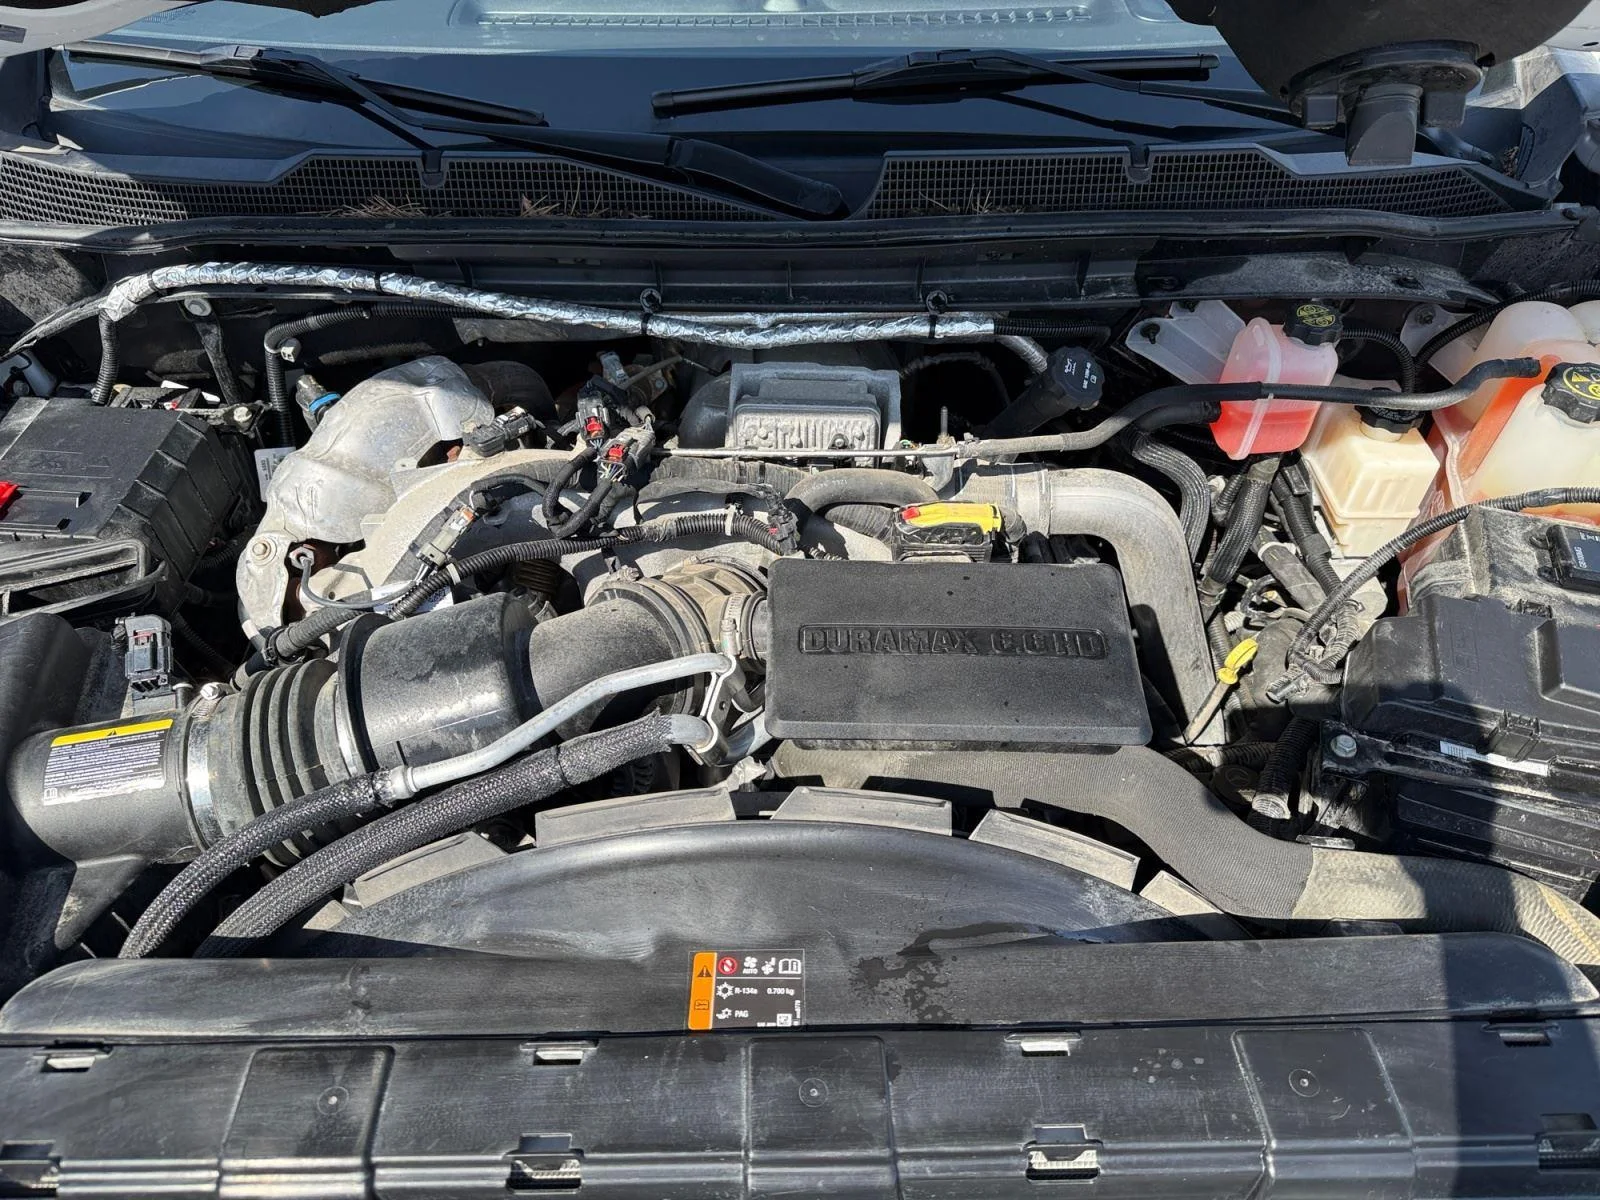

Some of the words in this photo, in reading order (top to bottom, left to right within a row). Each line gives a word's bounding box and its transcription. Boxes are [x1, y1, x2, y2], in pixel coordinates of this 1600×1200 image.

[802, 627, 978, 654] DURAMAX
[734, 987, 758, 995] R-134a
[786, 988, 795, 996] kg
[734, 1010, 749, 1018] PAG
